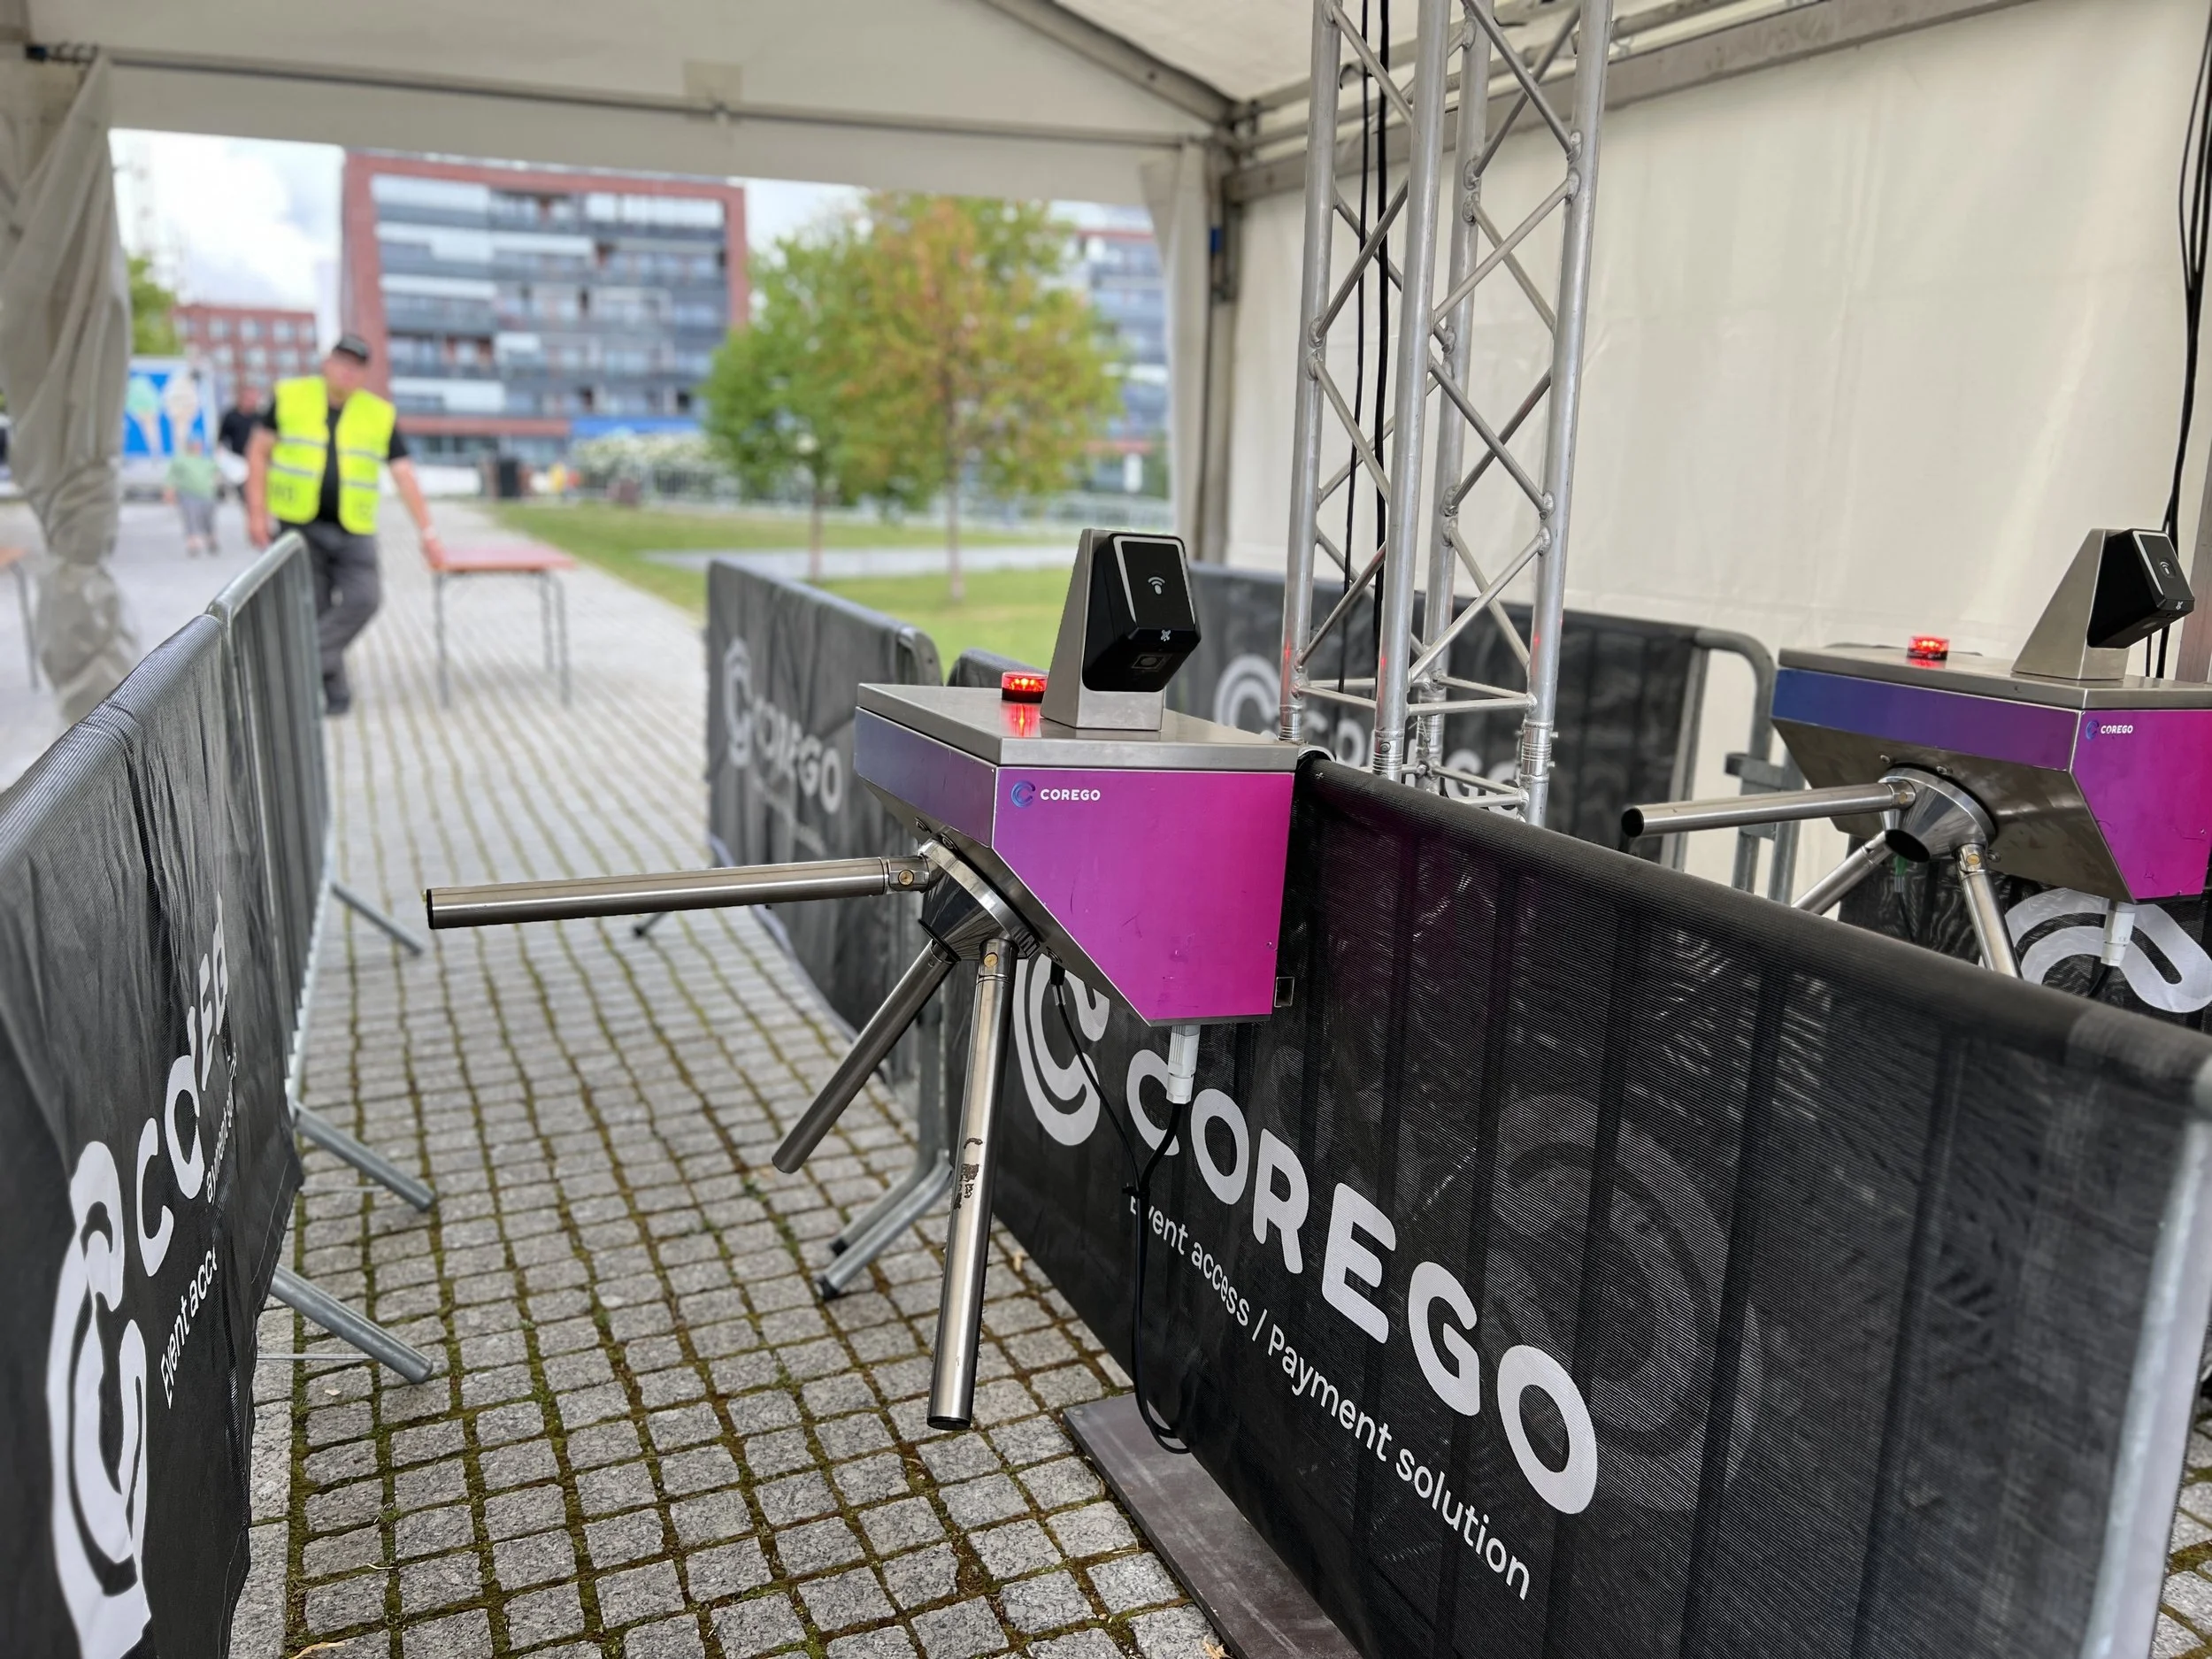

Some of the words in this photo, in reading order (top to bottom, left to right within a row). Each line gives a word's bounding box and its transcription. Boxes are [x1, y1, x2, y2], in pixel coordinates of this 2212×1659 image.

[2101, 725, 2133, 734] COREGO
[1040, 788, 1101, 801] COREGO
[1126, 1049, 1598, 1514] COREGO
[161, 1295, 190, 1409] Event
[1191, 1241, 1249, 1326] access
[1251, 1309, 1268, 1342] /
[1268, 1324, 1392, 1461] Payment
[1396, 1448, 1530, 1601] solution
